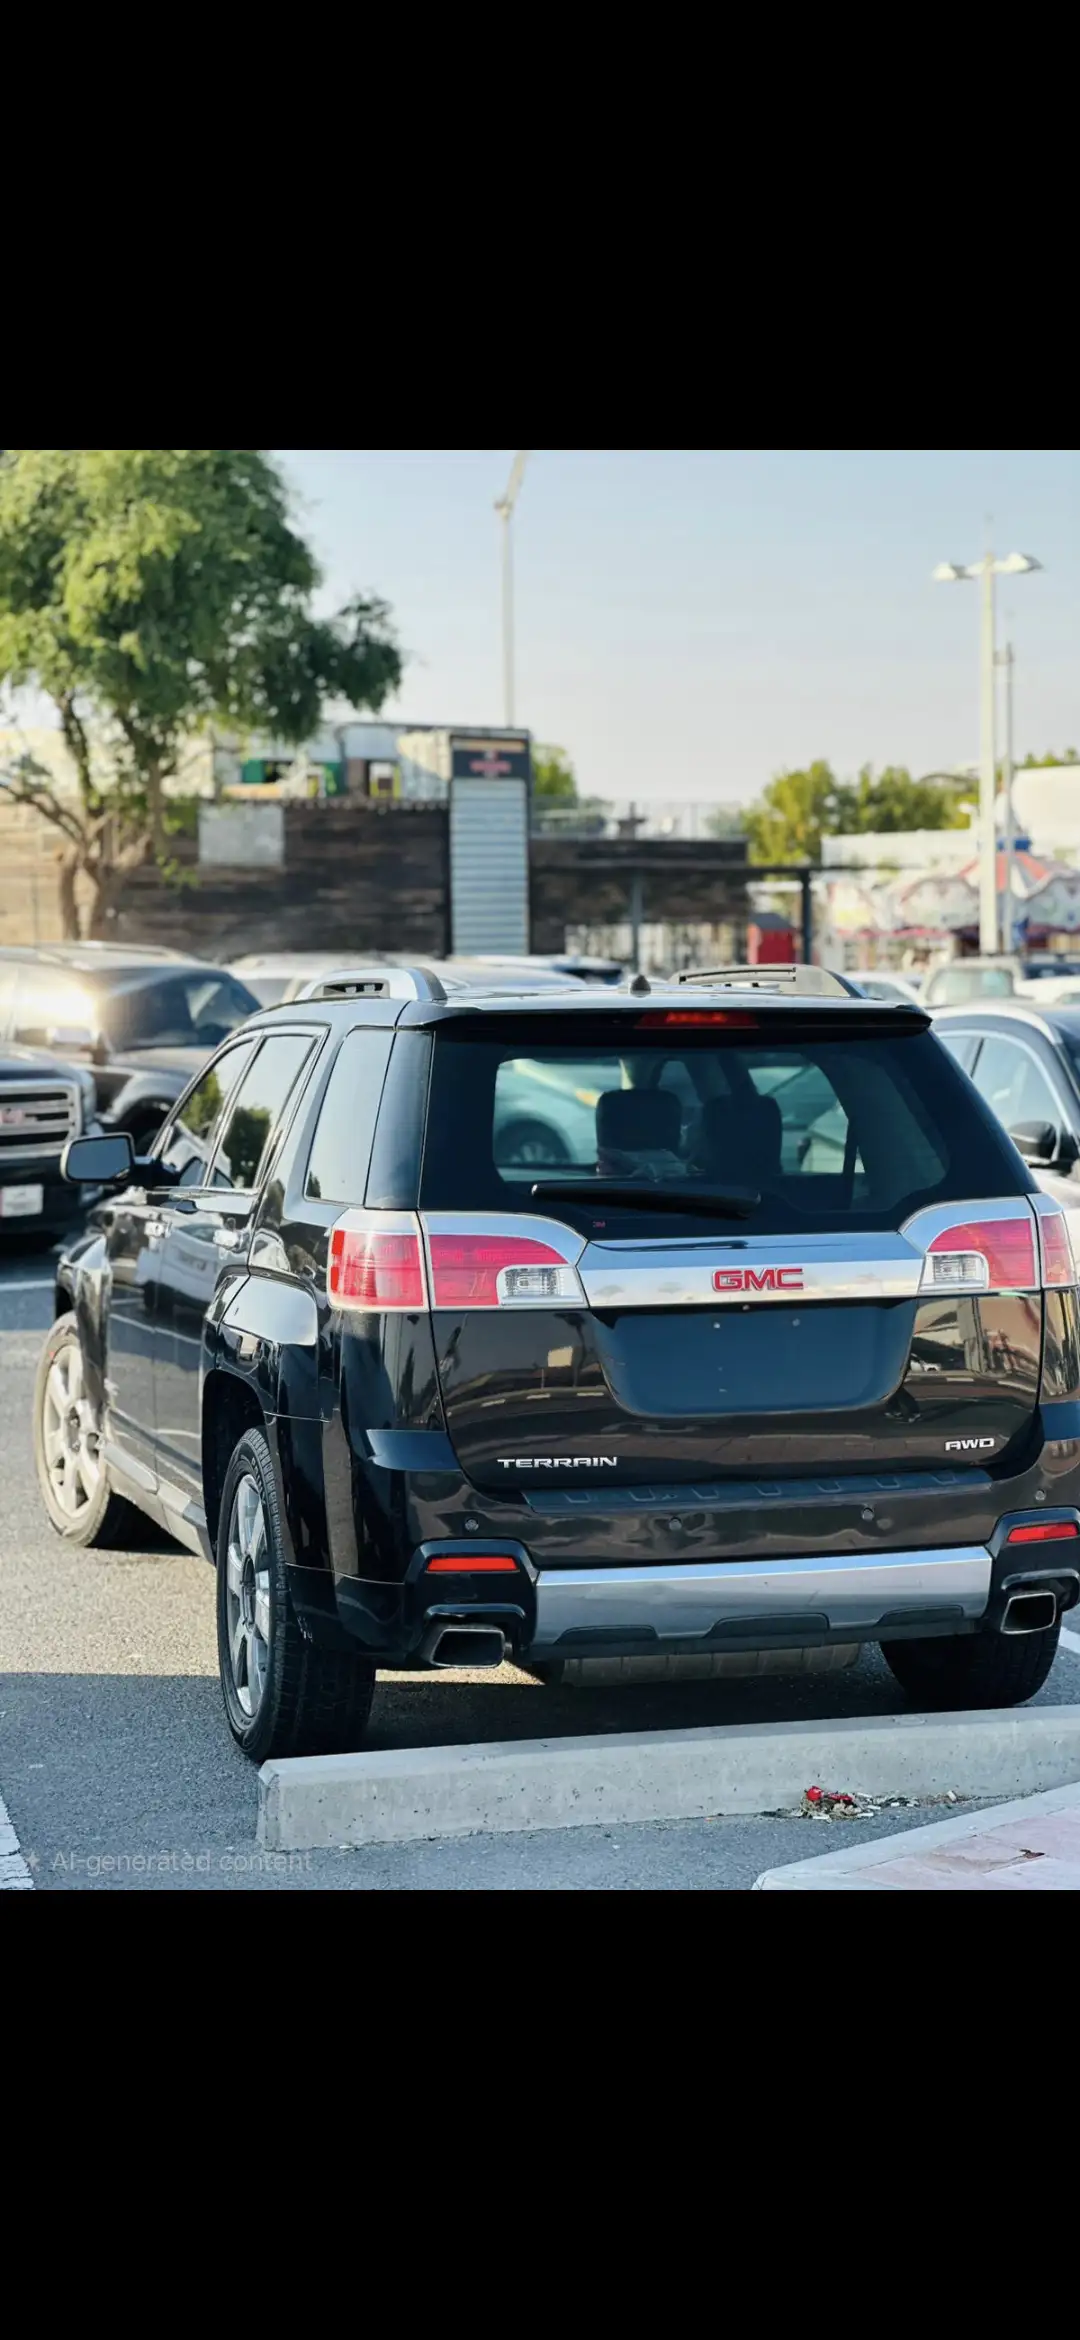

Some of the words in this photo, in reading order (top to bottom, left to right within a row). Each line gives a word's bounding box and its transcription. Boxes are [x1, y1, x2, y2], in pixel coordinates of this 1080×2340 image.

[713, 1268, 804, 1292] GMC
[945, 1437, 995, 1451] AWD
[497, 1456, 618, 1469] TERRAIN
